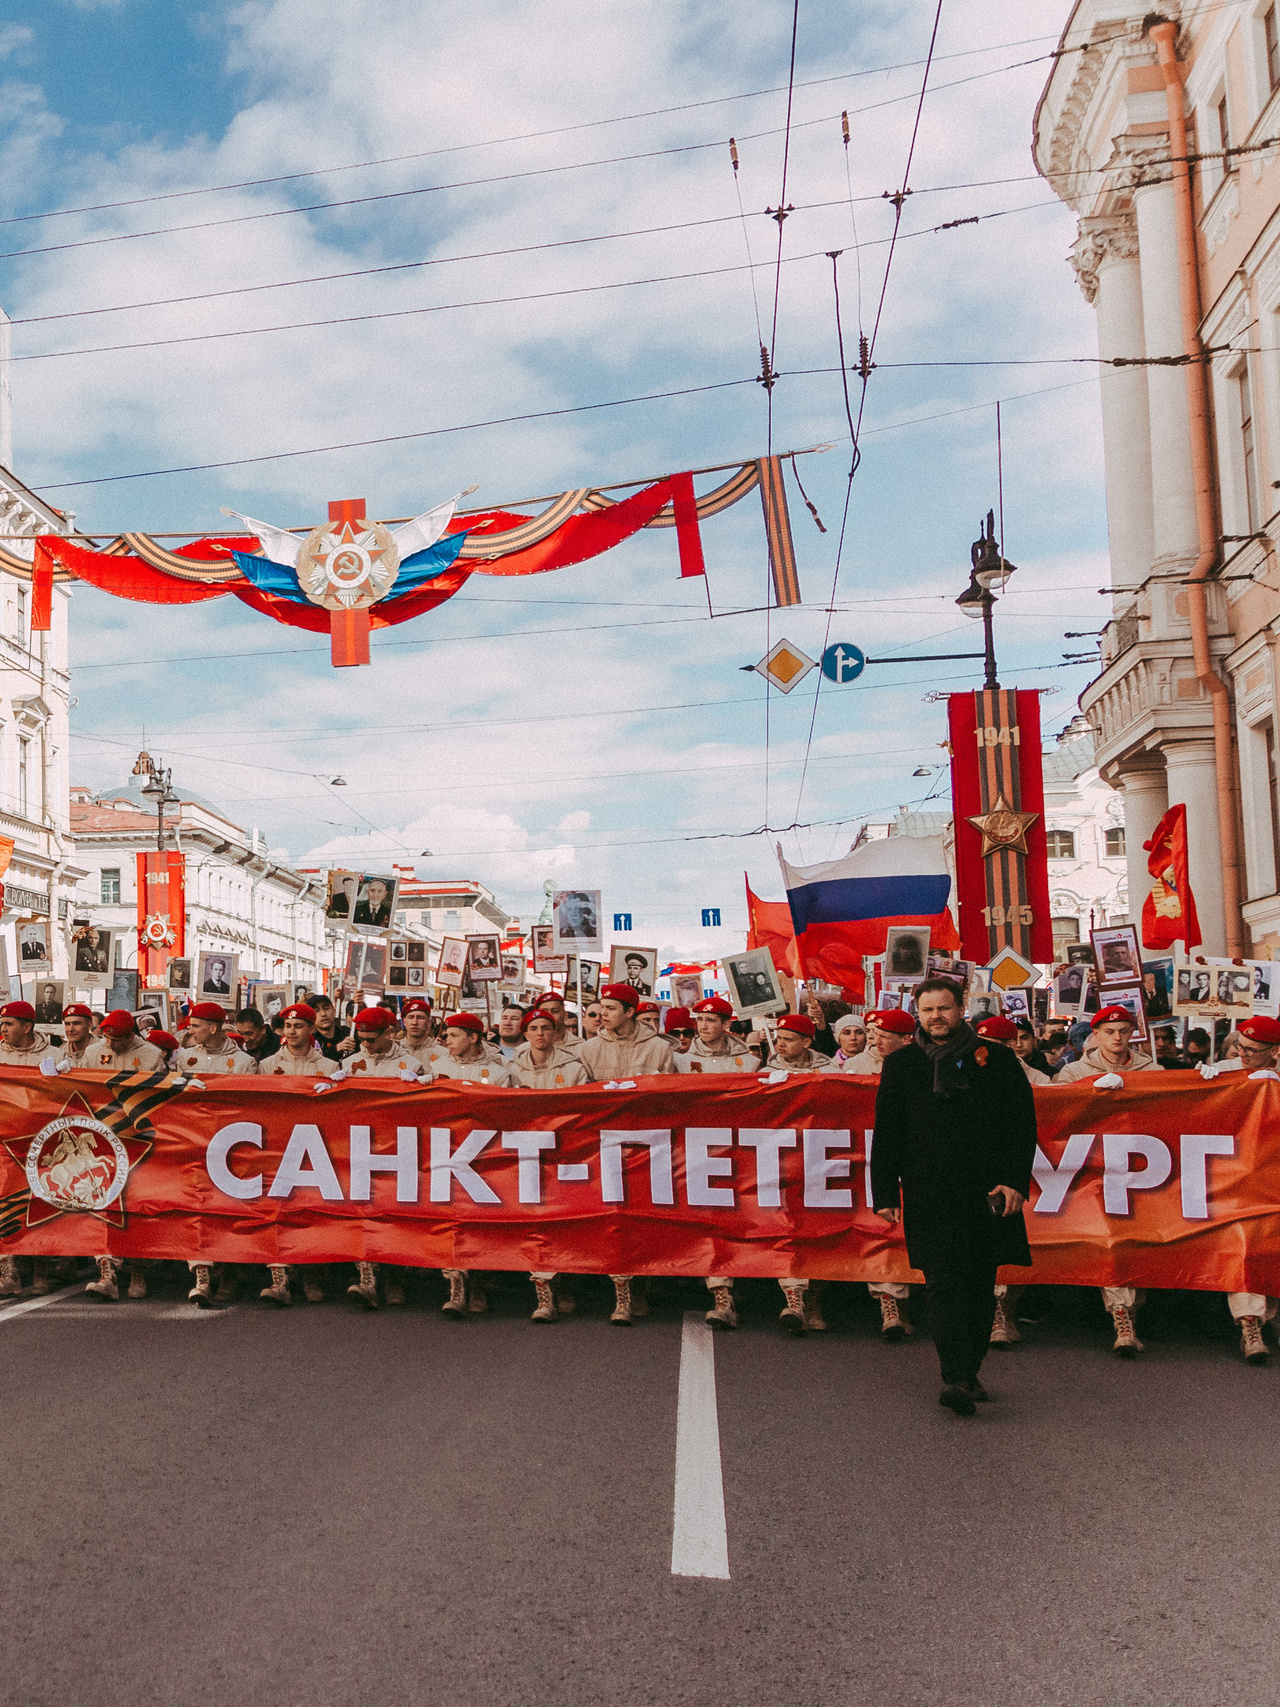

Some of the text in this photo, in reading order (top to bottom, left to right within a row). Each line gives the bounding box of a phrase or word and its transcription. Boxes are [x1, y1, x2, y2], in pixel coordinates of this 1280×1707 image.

[973, 725, 1021, 747] 1941
[145, 871, 170, 885] 1941
[981, 904, 1034, 928] 1945
[145, 974, 166, 988] 194
[28, 1117, 128, 1186] БЕССМЕРТНЫЙ ПОЛК РОССИИ
[206, 1121, 1236, 1219] САНКТ-ПЕТЕУРГ
